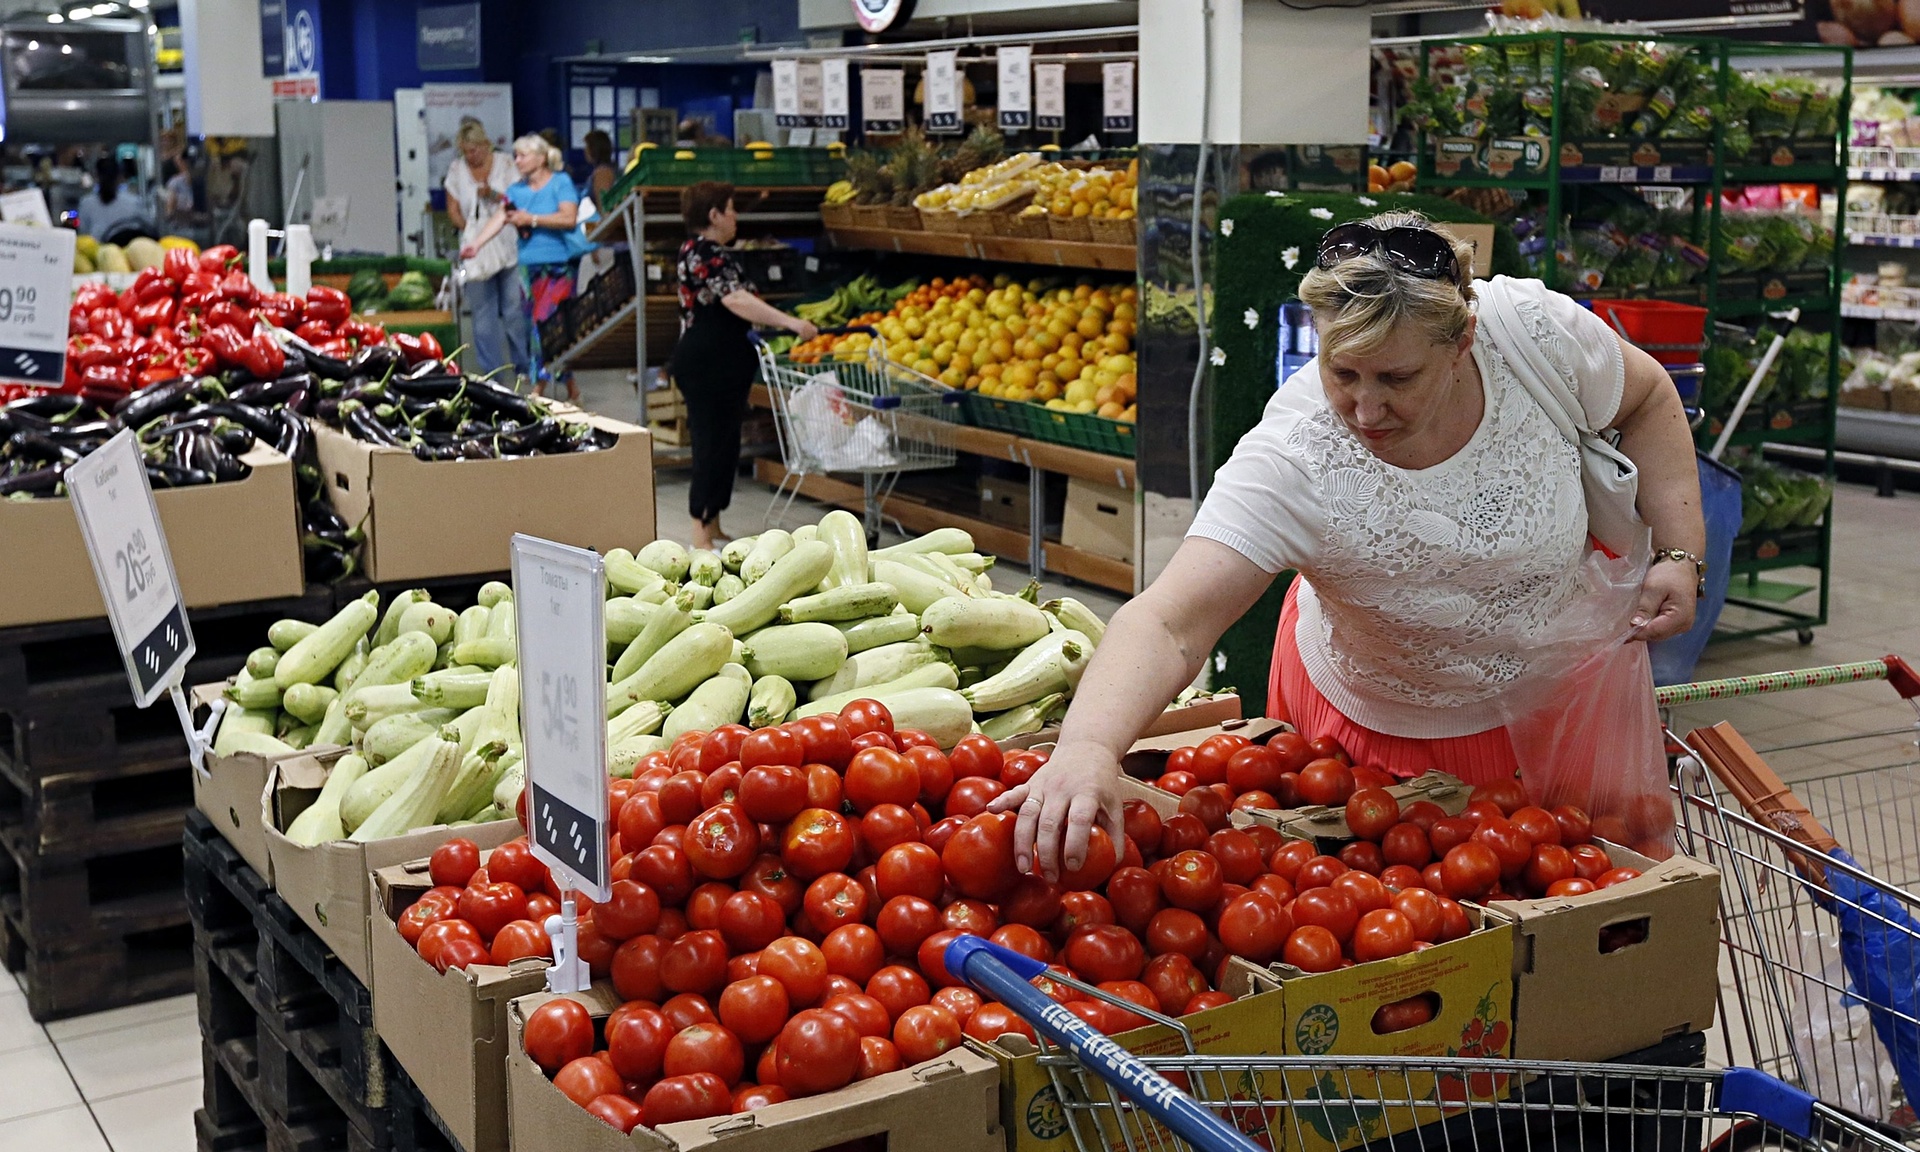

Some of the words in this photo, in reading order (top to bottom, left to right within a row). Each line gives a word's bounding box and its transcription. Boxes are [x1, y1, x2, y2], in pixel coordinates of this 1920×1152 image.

[16, 286, 37, 303] 90
[115, 541, 146, 603] 26
[132, 528, 147, 555] 90
[540, 566, 569, 591] Томаты
[541, 670, 564, 747] 54
[563, 673, 577, 709] 90
